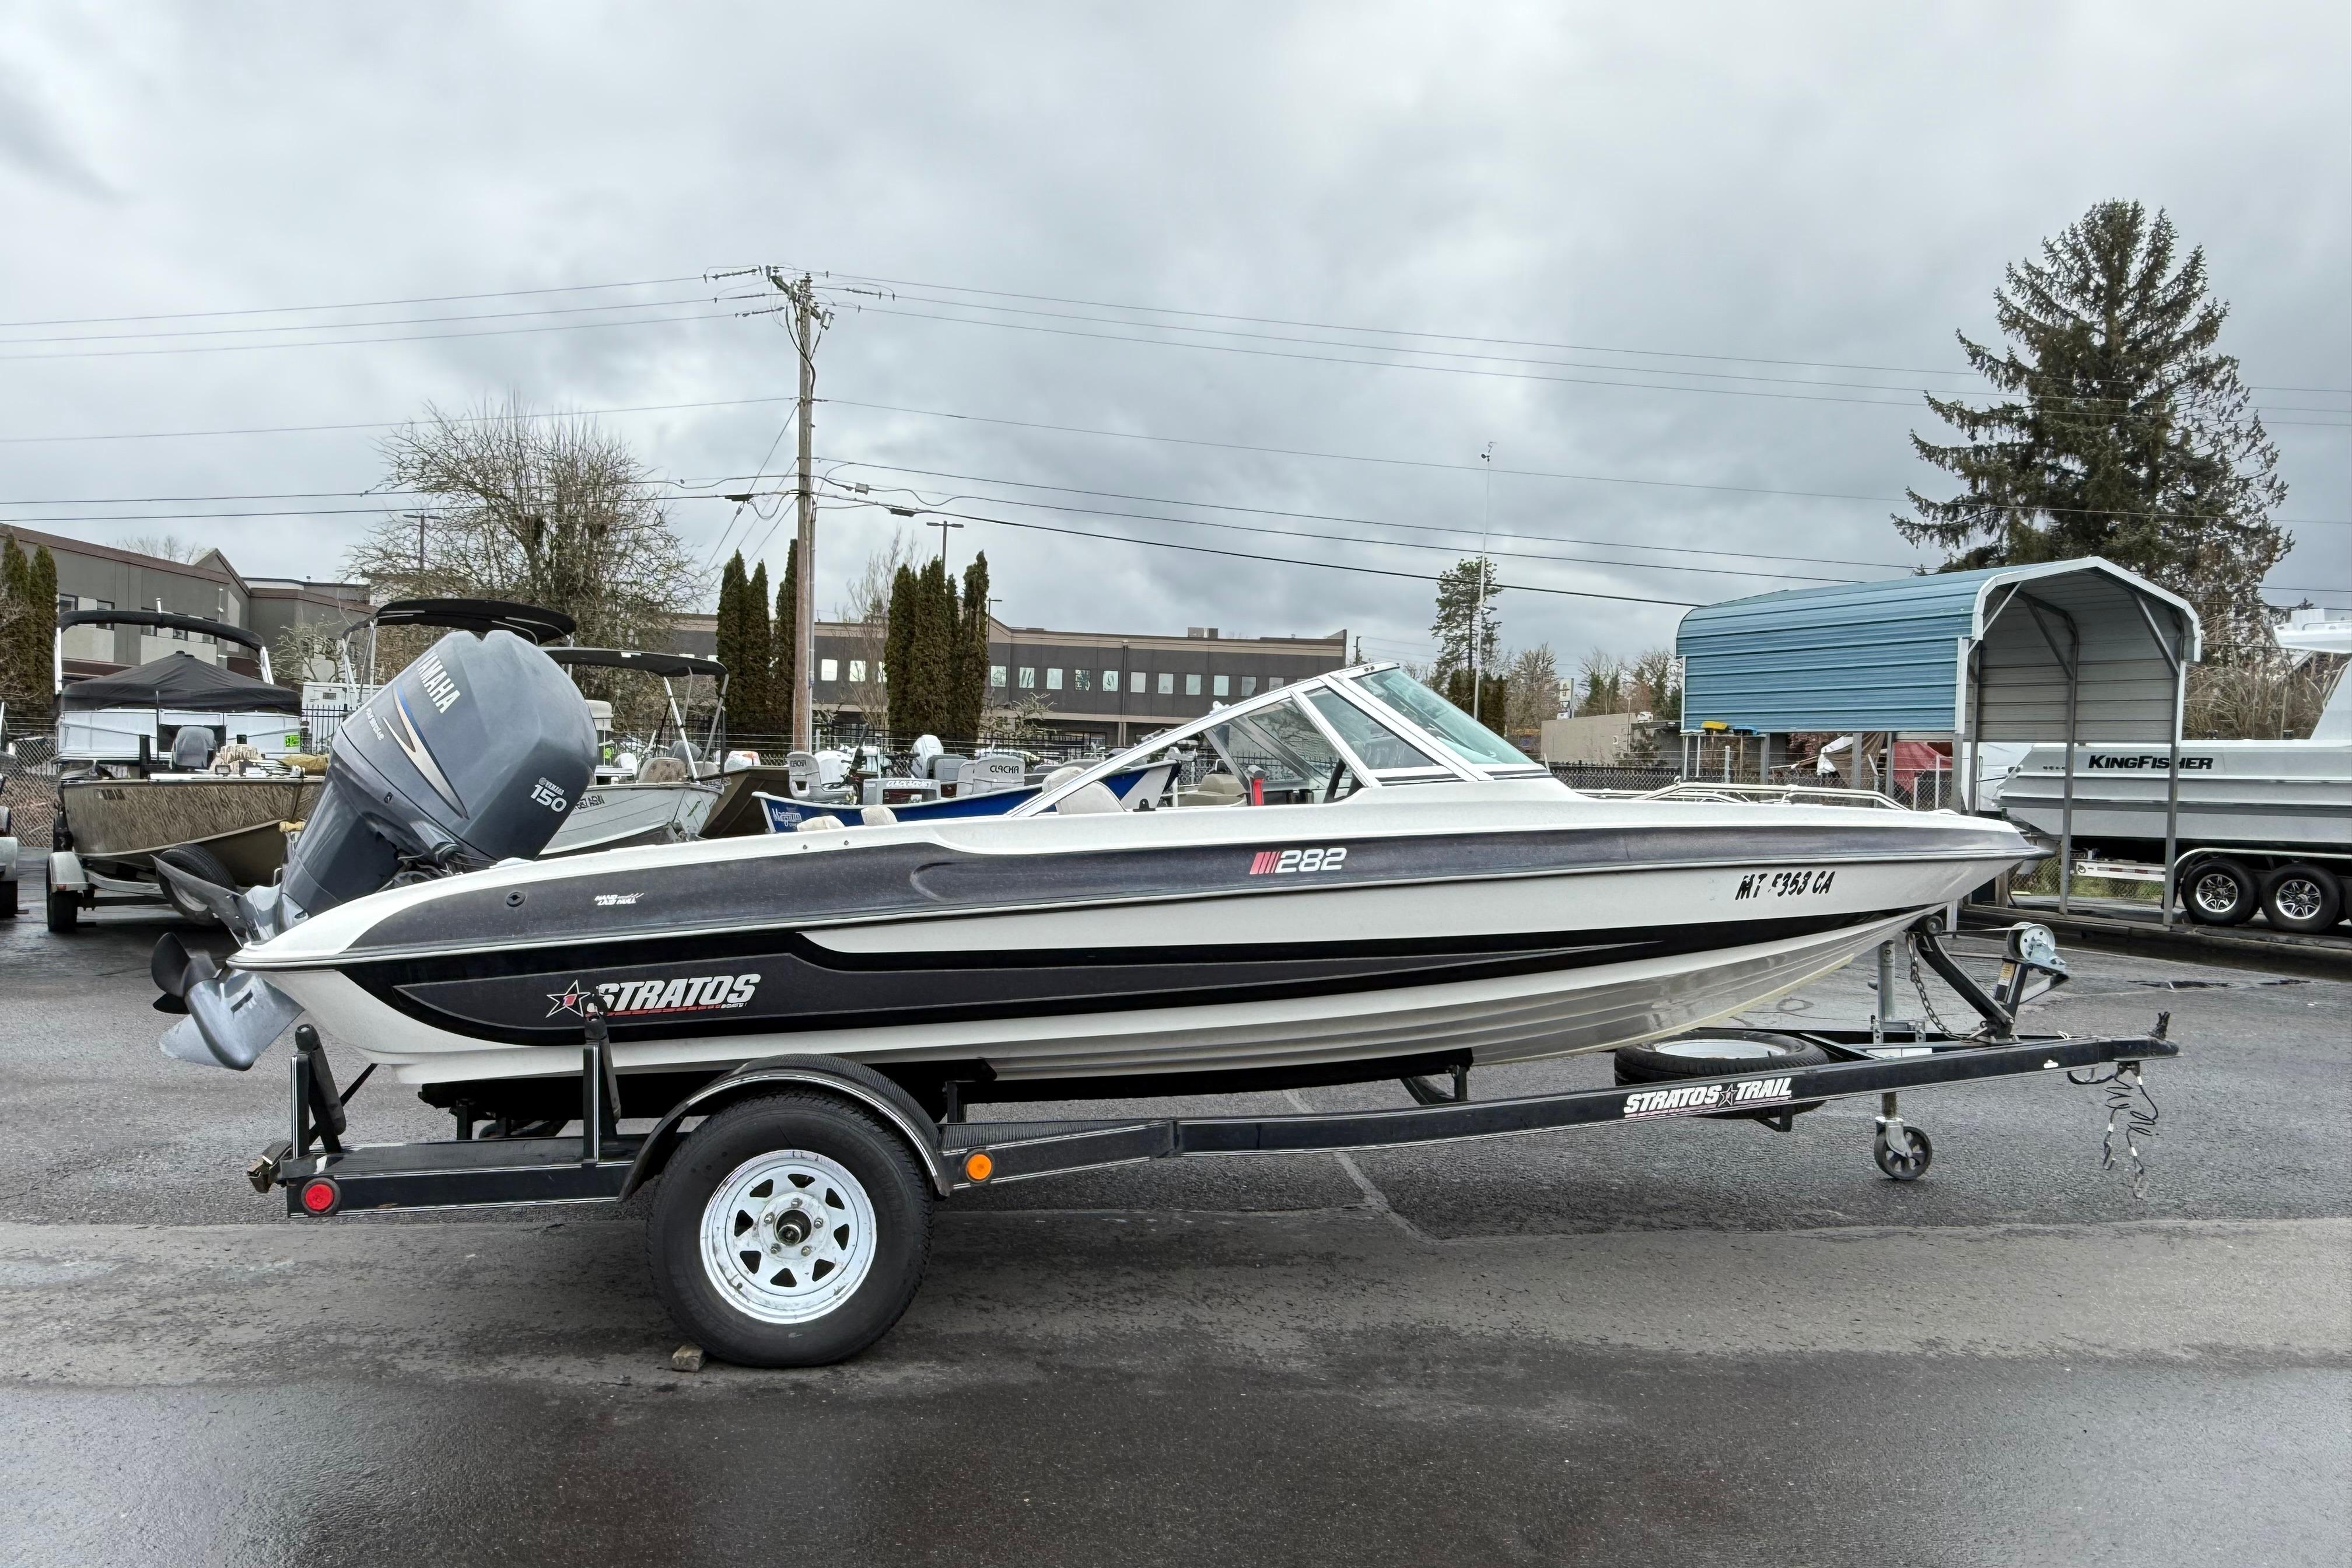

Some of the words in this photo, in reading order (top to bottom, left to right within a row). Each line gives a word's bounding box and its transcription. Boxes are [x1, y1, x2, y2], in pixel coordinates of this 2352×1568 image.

[417, 648, 460, 714] YAMAHA
[530, 784, 567, 812] 150
[1274, 847, 1348, 874] 282
[1735, 873, 1768, 900] MT
[1812, 870, 1835, 894] CA
[586, 974, 761, 1013] STRATOS
[1623, 1085, 1721, 1113] STRATOS
[1735, 1077, 1791, 1101] TRAIL
